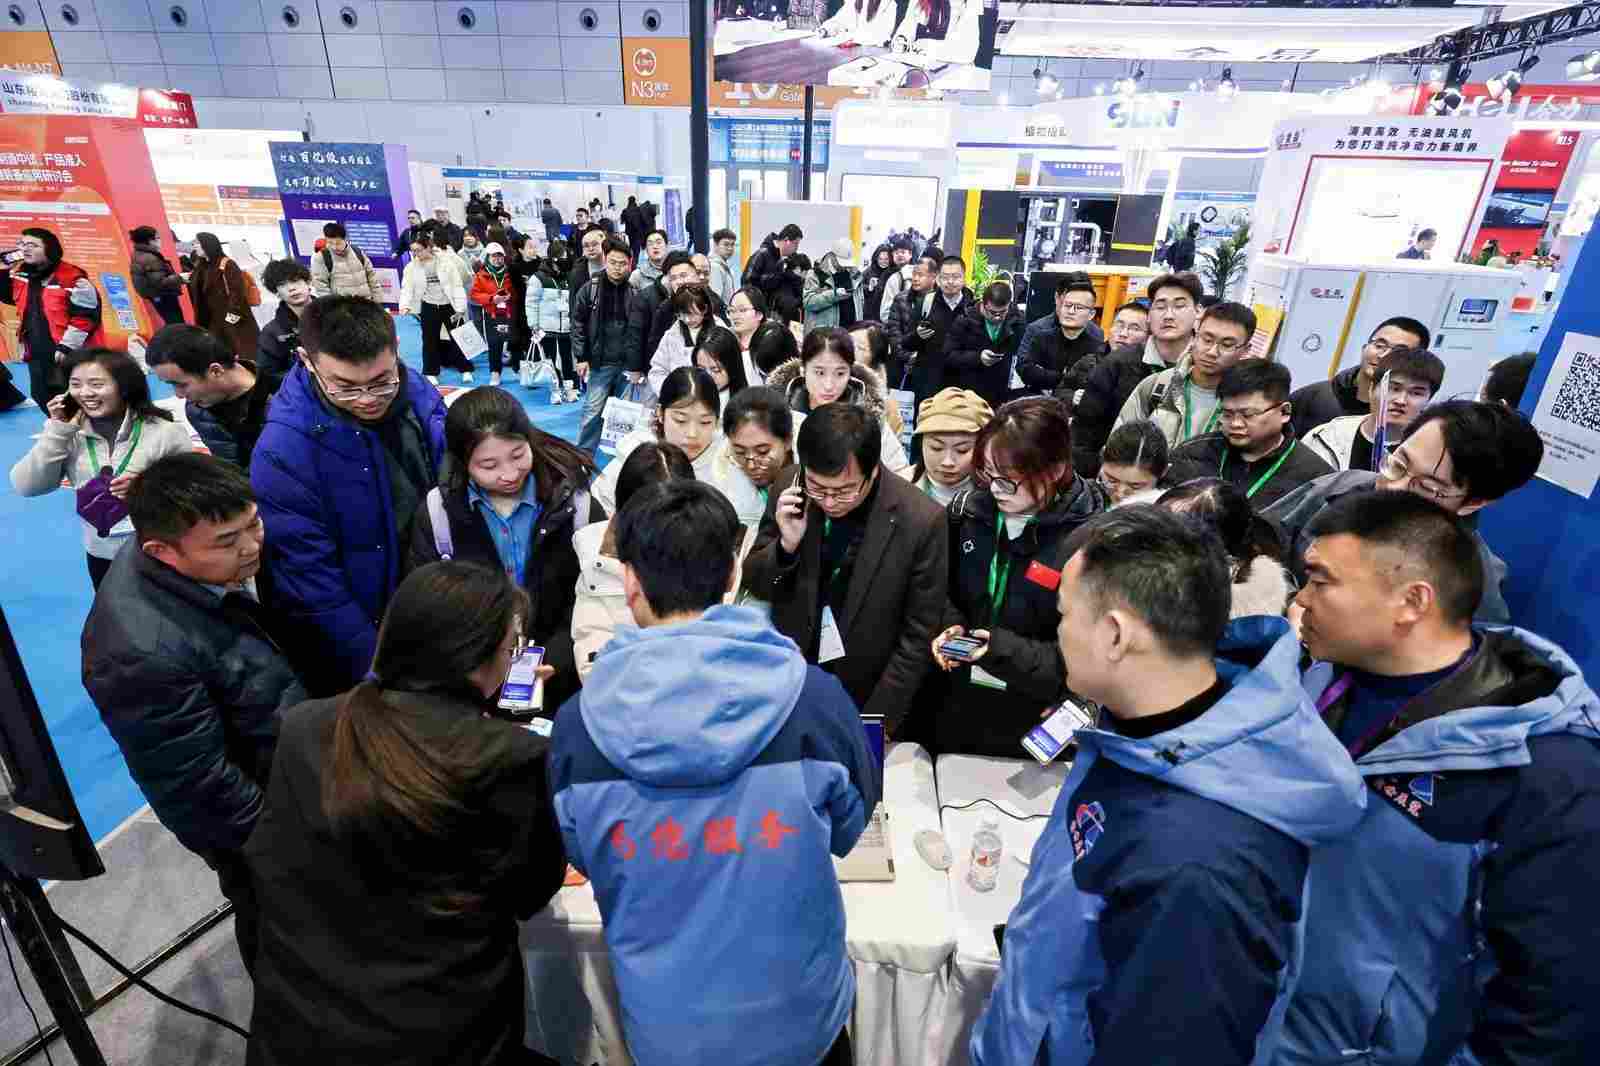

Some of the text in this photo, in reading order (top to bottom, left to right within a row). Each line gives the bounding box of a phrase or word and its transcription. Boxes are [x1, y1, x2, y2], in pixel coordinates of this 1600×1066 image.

[1407, 126, 1473, 138] 无油鼓风机
[1333, 139, 1479, 151] 为您打造纯净动力新境界
